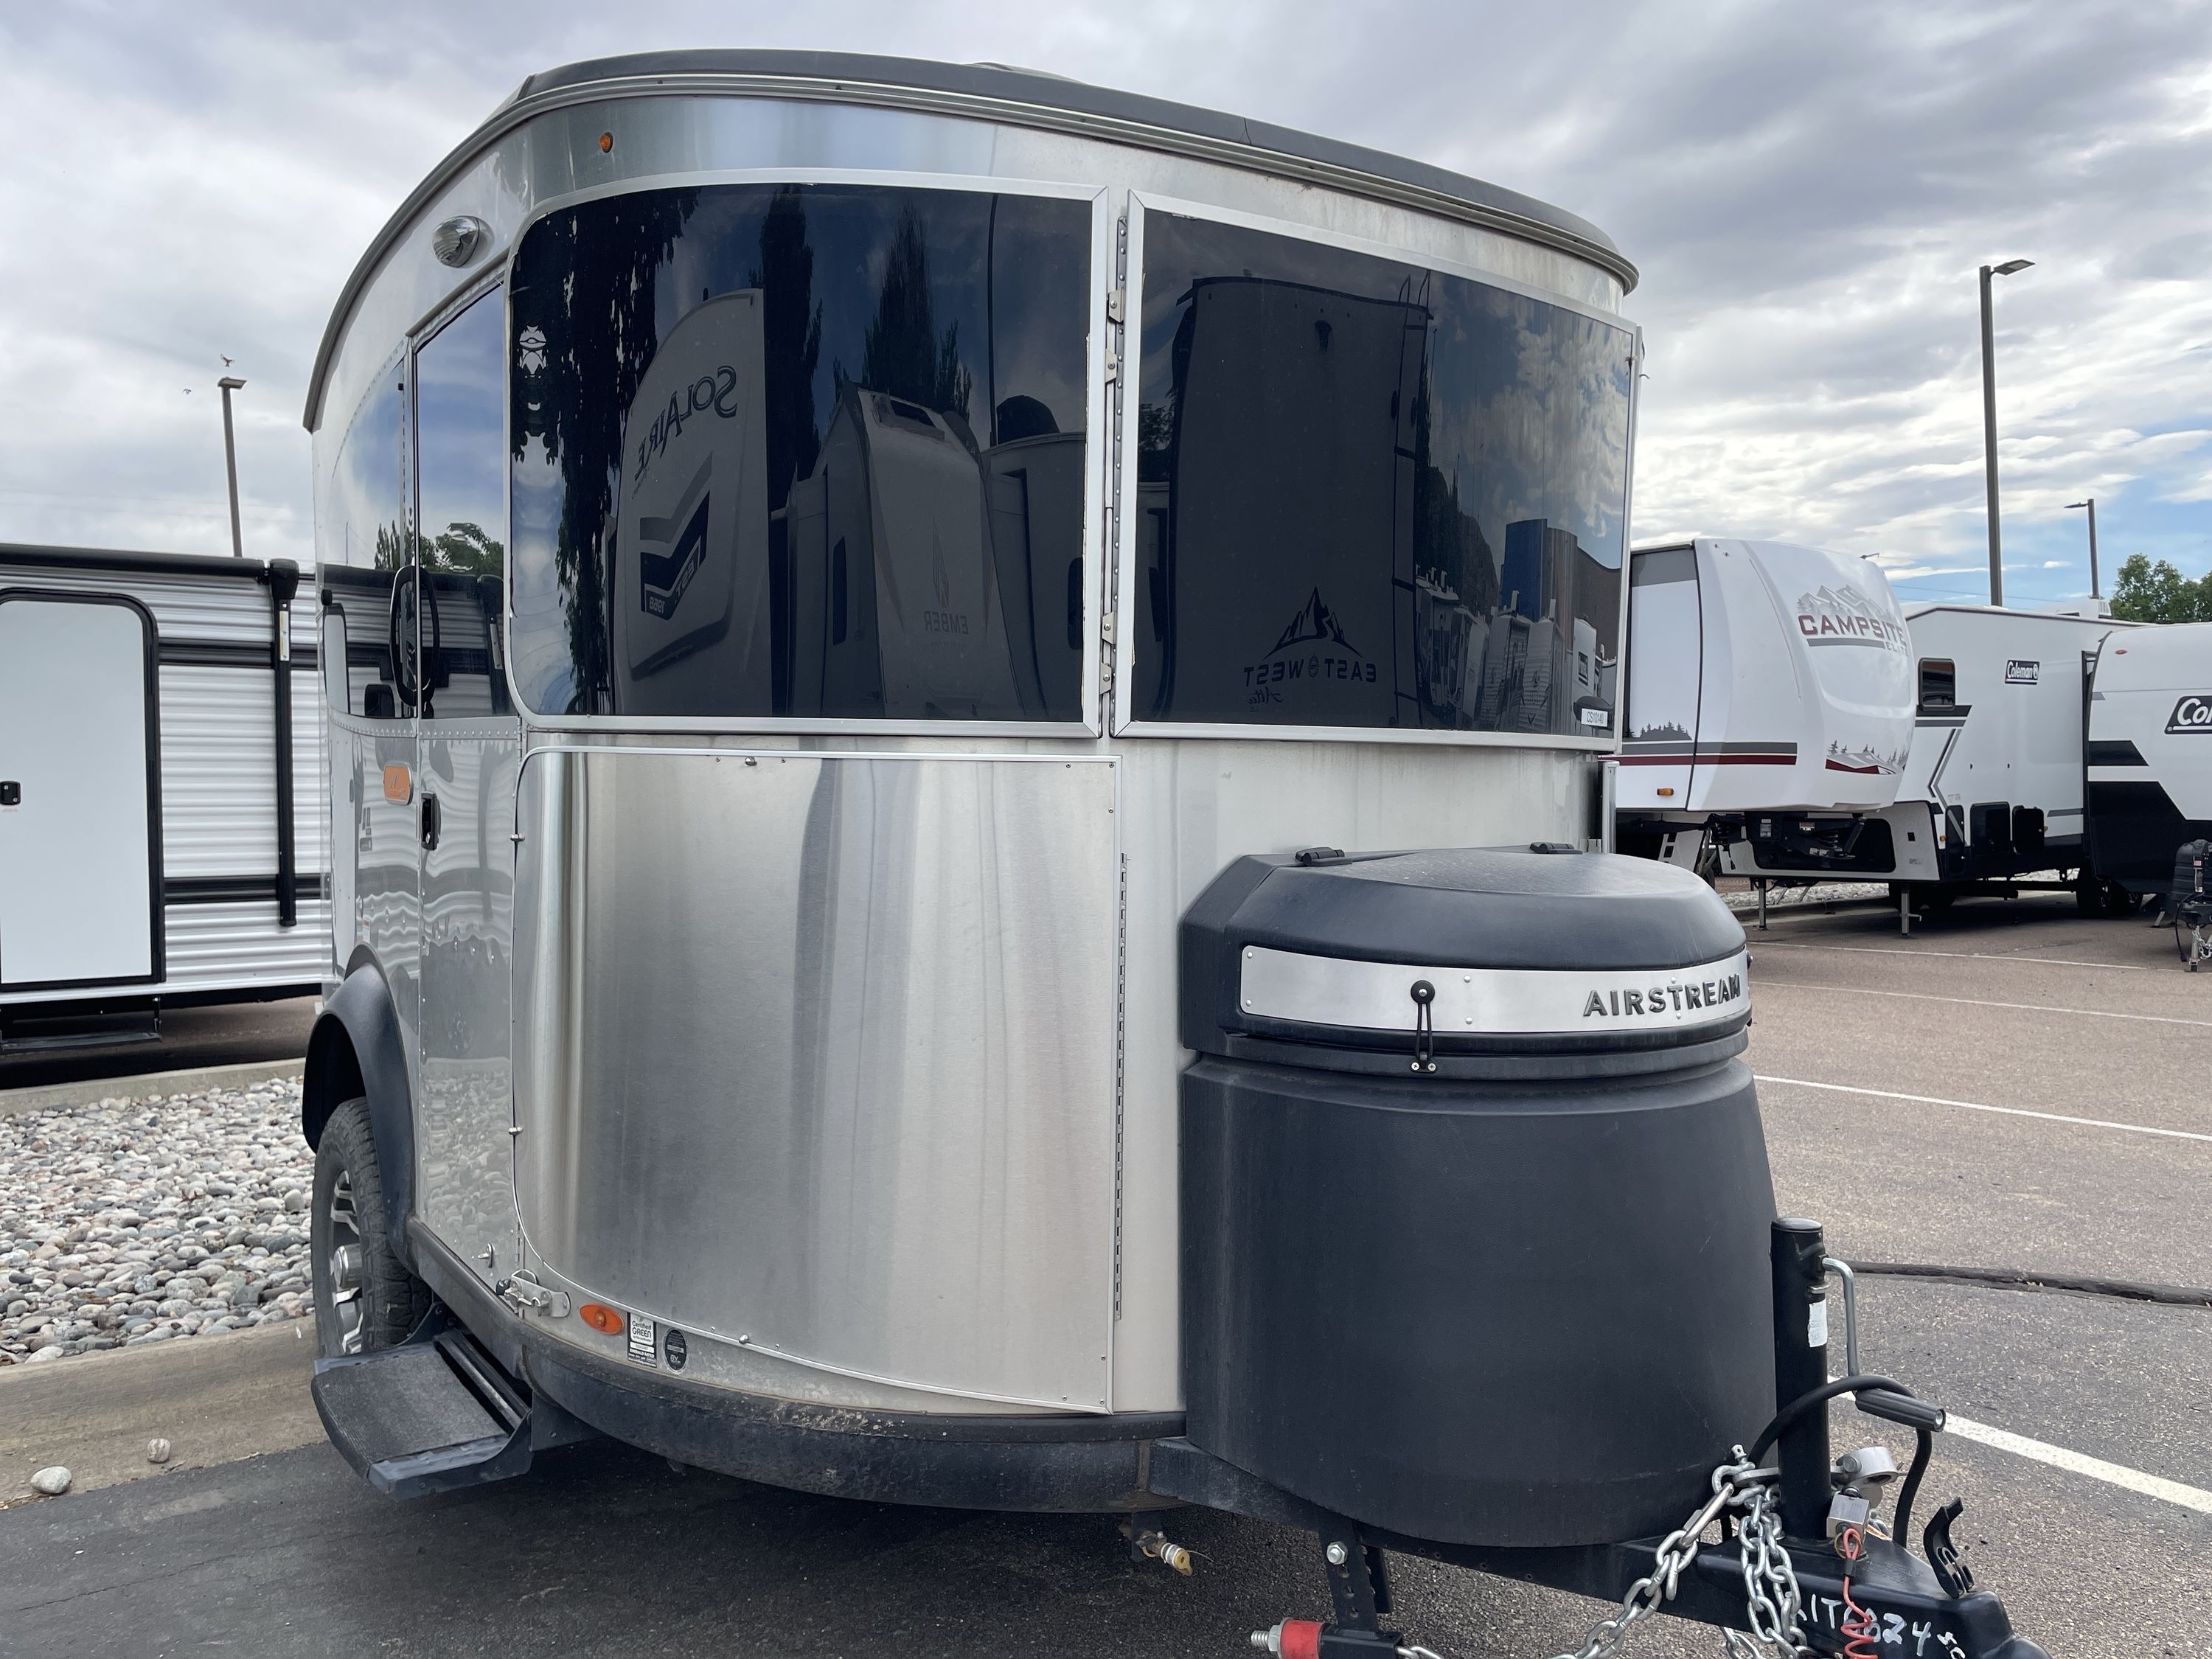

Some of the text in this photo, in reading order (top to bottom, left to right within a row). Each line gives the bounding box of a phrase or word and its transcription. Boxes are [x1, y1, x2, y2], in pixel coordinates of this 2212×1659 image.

[1798, 614, 1907, 647] CAMPSITE
[2007, 661, 2034, 679] Coleman
[1583, 973, 1741, 1017] AIRSTREAM
[632, 1320, 652, 1330] Certified
[632, 1327, 652, 1338] GREEN
